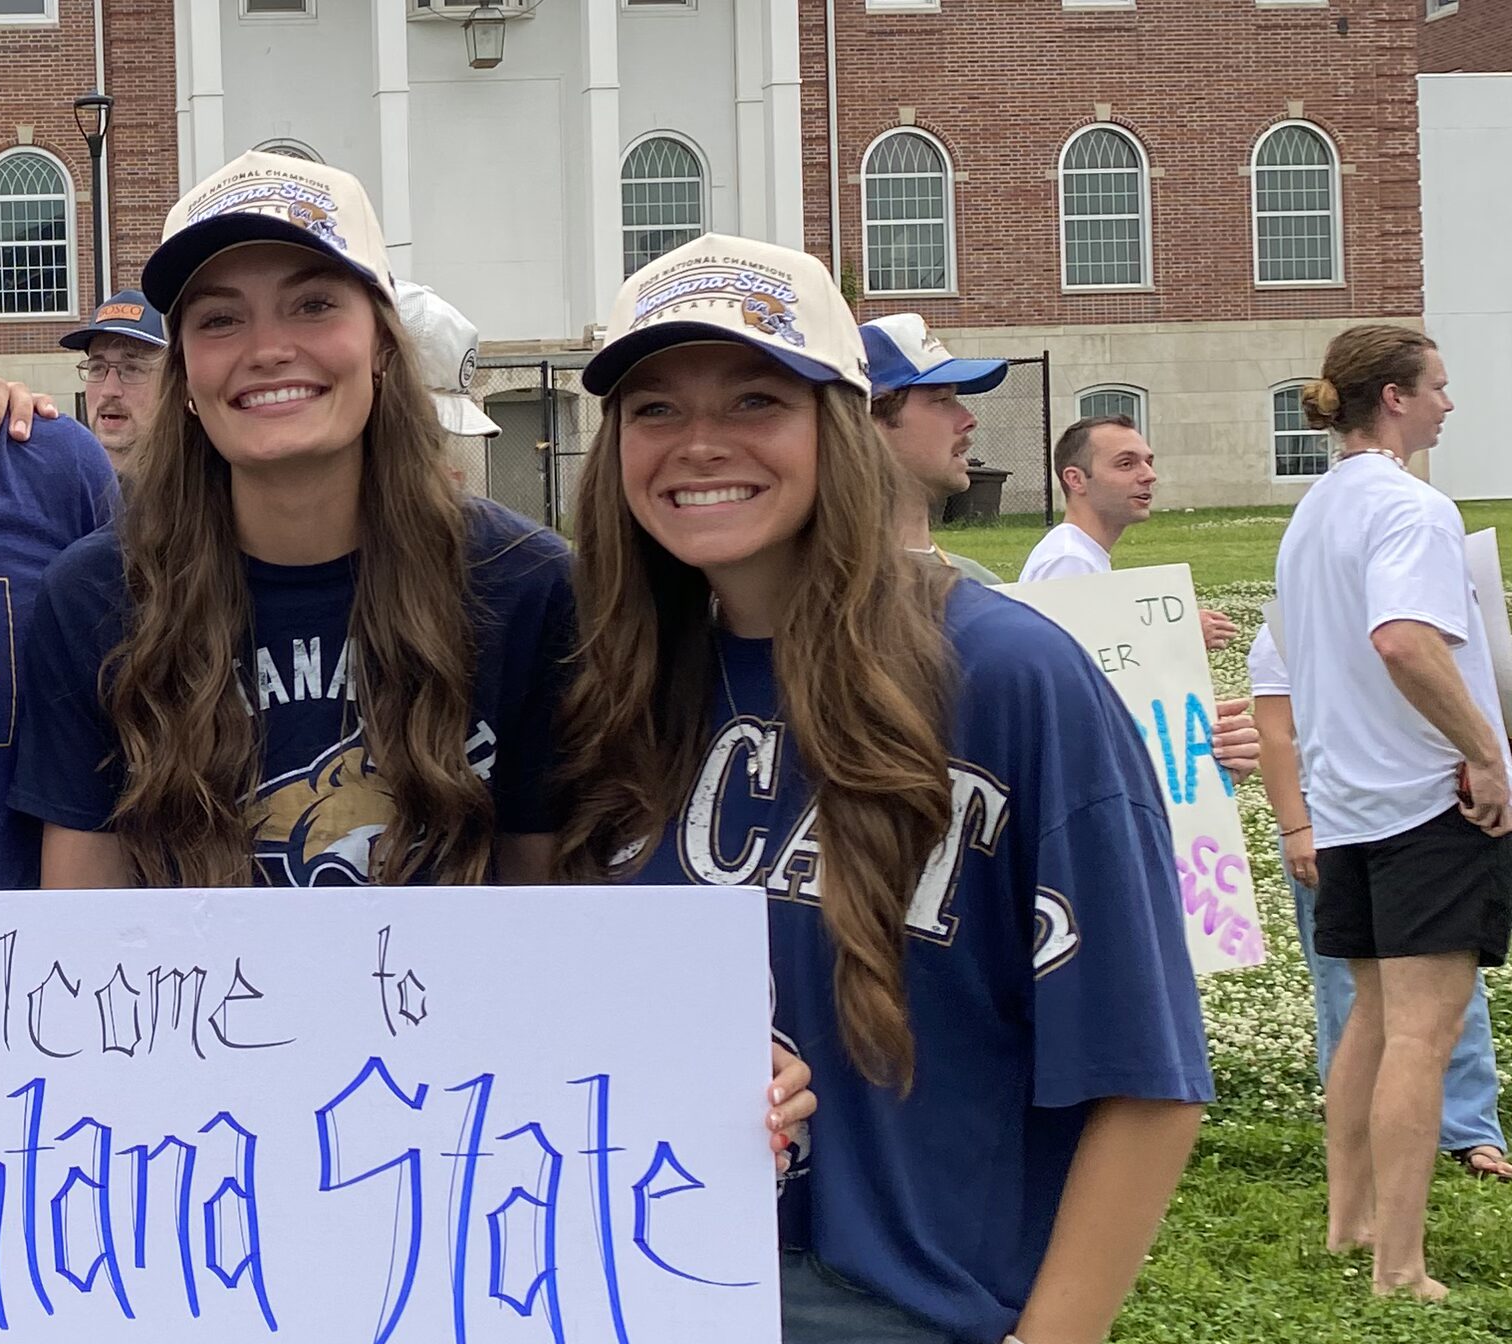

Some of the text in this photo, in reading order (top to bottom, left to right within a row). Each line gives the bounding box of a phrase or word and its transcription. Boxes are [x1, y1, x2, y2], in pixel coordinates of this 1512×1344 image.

[209, 170, 261, 193] NATIONAL
[265, 169, 331, 191] CHAMPIONS
[280, 181, 338, 211] State
[662, 256, 717, 276] NATIONAL
[723, 257, 793, 280] CHAMPIONS
[629, 271, 799, 330] Montana State
[1135, 596, 1184, 626] JD
[371, 925, 428, 1036] to
